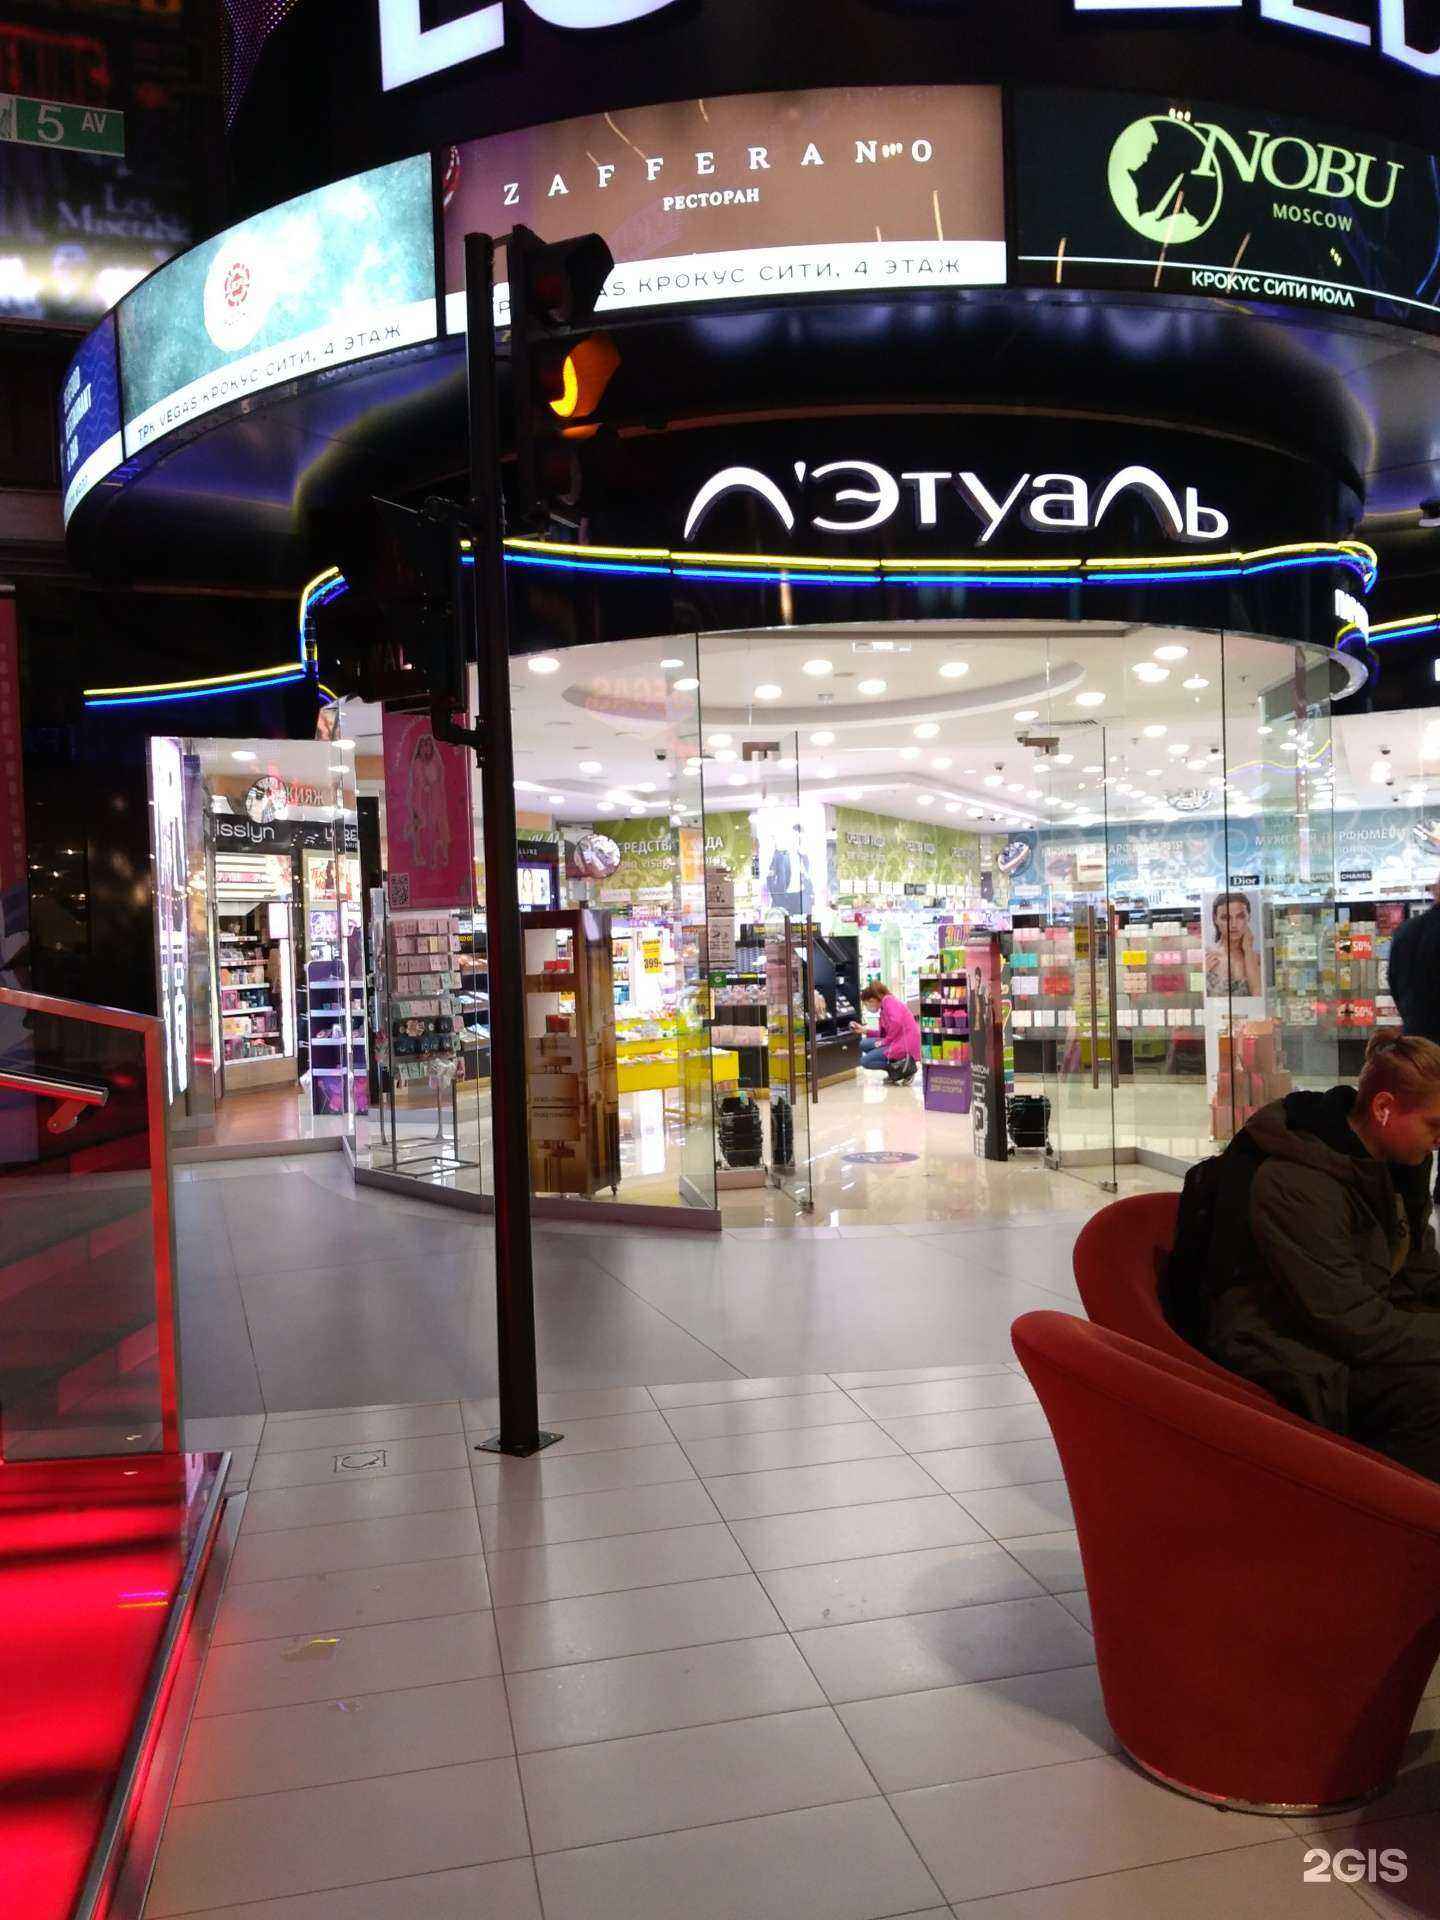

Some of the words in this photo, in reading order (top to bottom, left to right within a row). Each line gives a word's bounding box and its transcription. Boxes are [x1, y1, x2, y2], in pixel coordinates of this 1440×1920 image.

[37, 104, 64, 142] 5
[81, 111, 107, 133] AV
[503, 139, 933, 205] ZAFFERANO
[1191, 121, 1404, 208] NOBU
[663, 188, 760, 211] РЕСТОРАН
[1273, 203, 1353, 231] MOSCOW
[639, 266, 745, 293] КРОКУС
[885, 259, 961, 274] ЭТАЖ
[1191, 271, 1260, 294] КРОКУС
[1264, 278, 1307, 299] СИТИ
[1311, 285, 1355, 307] МОЛЛ
[160, 397, 197, 427] VEGAS
[344, 325, 401, 350] ЭТАЖ
[1232, 877, 1257, 886] Dior
